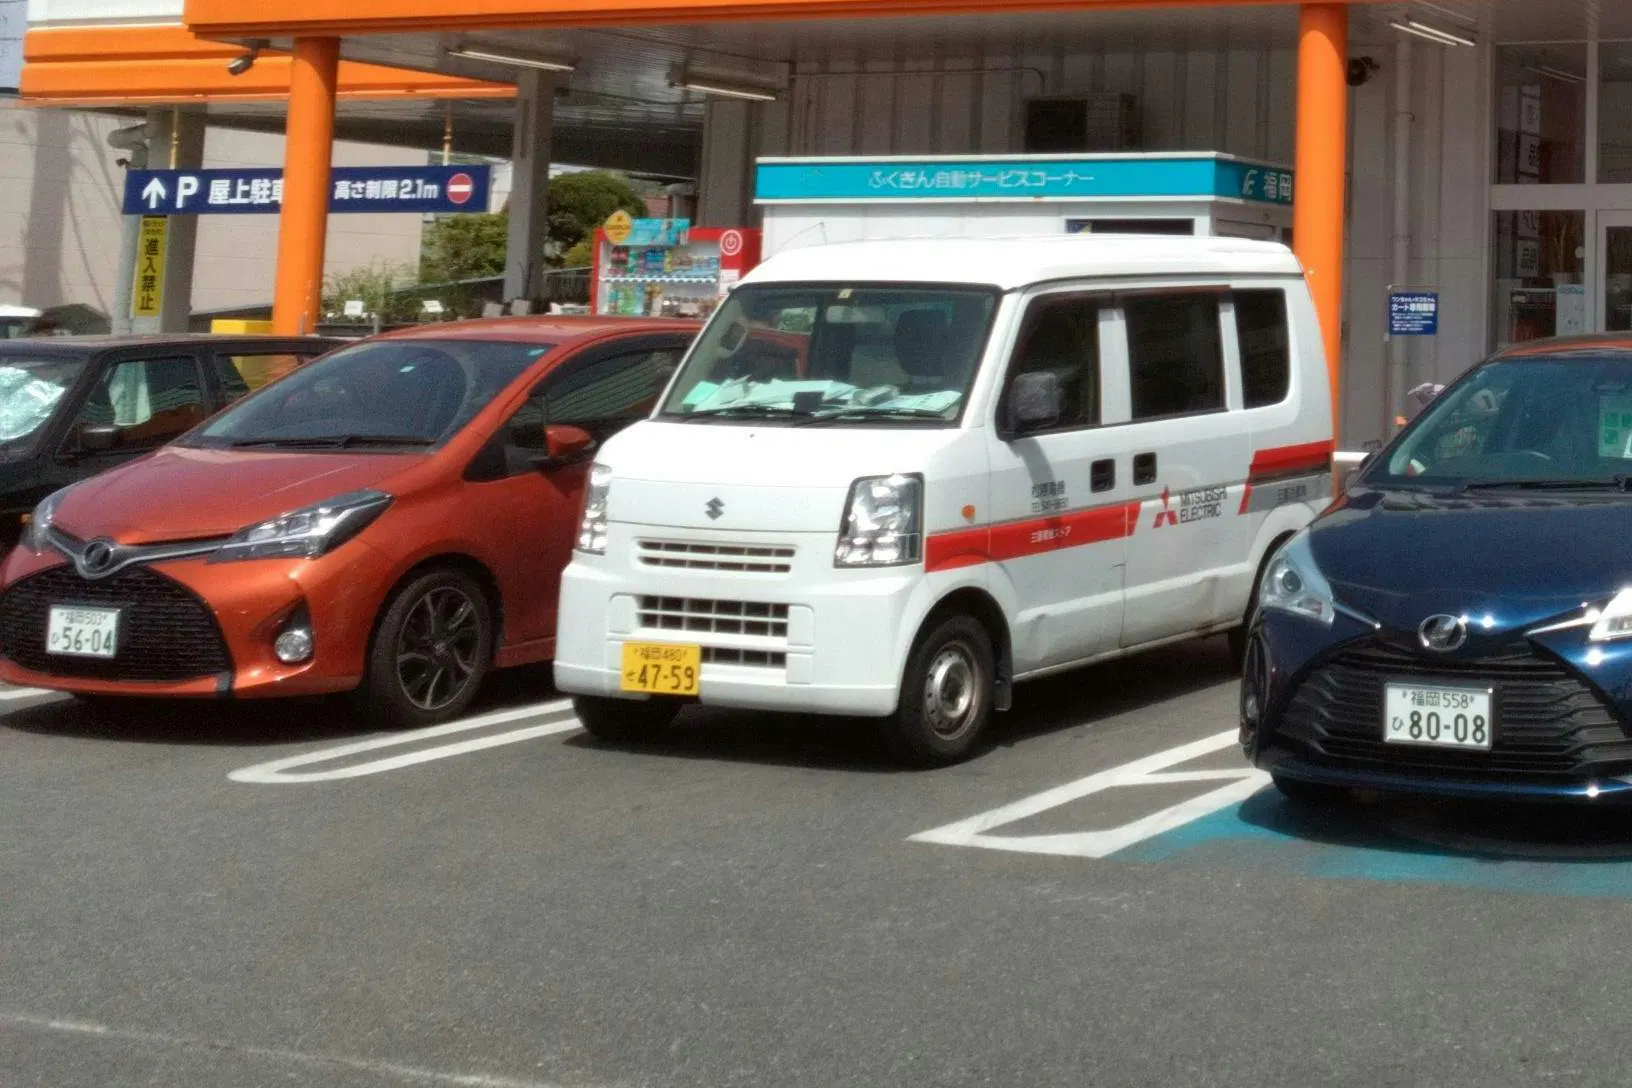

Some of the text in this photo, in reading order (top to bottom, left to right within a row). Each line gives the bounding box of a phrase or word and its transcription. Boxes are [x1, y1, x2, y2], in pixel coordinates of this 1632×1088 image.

[175, 176, 200, 209] P
[868, 168, 1096, 190] ふくぎん自動サービスコーナー
[139, 238, 160, 310] 進入禁止
[1180, 486, 1227, 508] MITSUBISHI
[1180, 503, 1222, 523] ELECTRIC
[62, 626, 113, 652] 56-04
[637, 663, 694, 691] 47-59
[1409, 710, 1486, 743] 80-08
